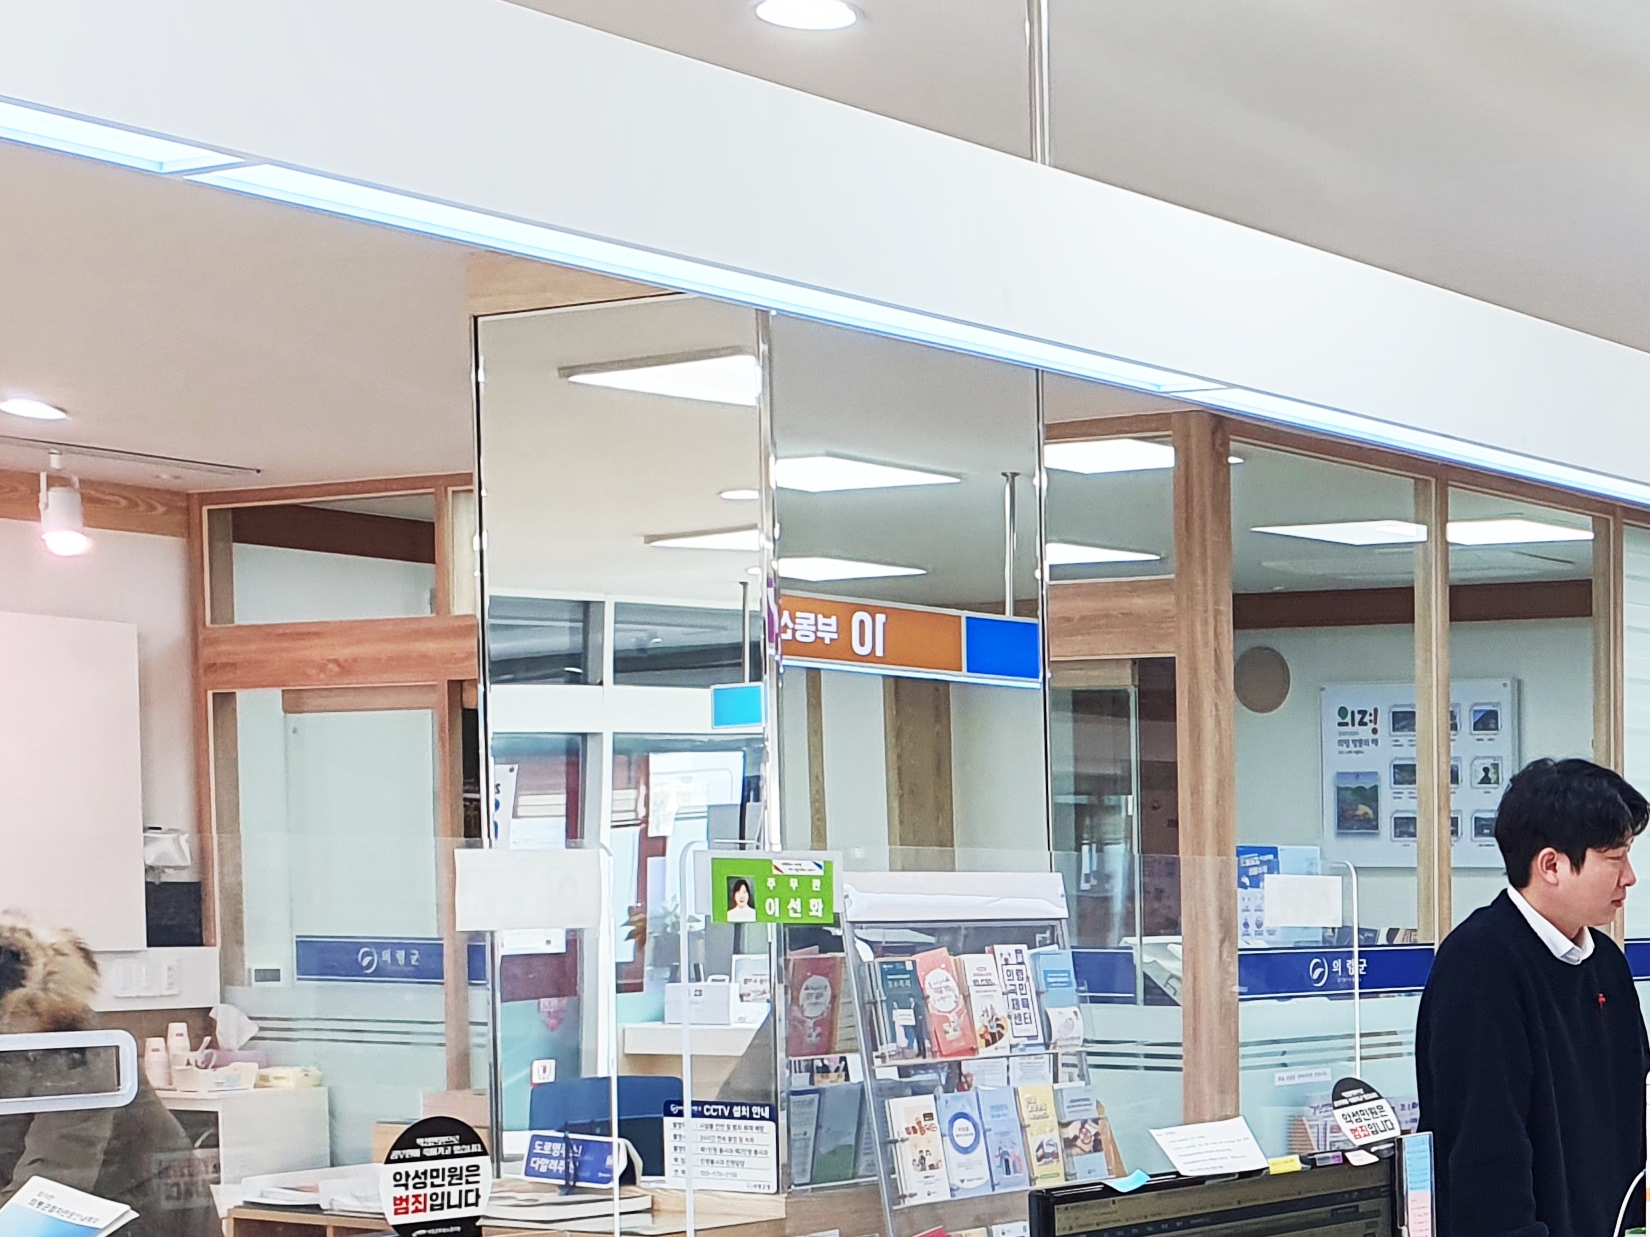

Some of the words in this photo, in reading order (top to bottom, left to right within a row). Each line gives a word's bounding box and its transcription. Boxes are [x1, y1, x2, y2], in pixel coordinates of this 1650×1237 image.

[765, 897, 824, 918] 이선화
[703, 1104, 730, 1117] CCTV
[752, 1106, 770, 1119] 안내
[1349, 1119, 1396, 1140] 범죄입니다
[393, 1164, 481, 1191] 악성민원은
[393, 1188, 481, 1216] 범죄입니다
